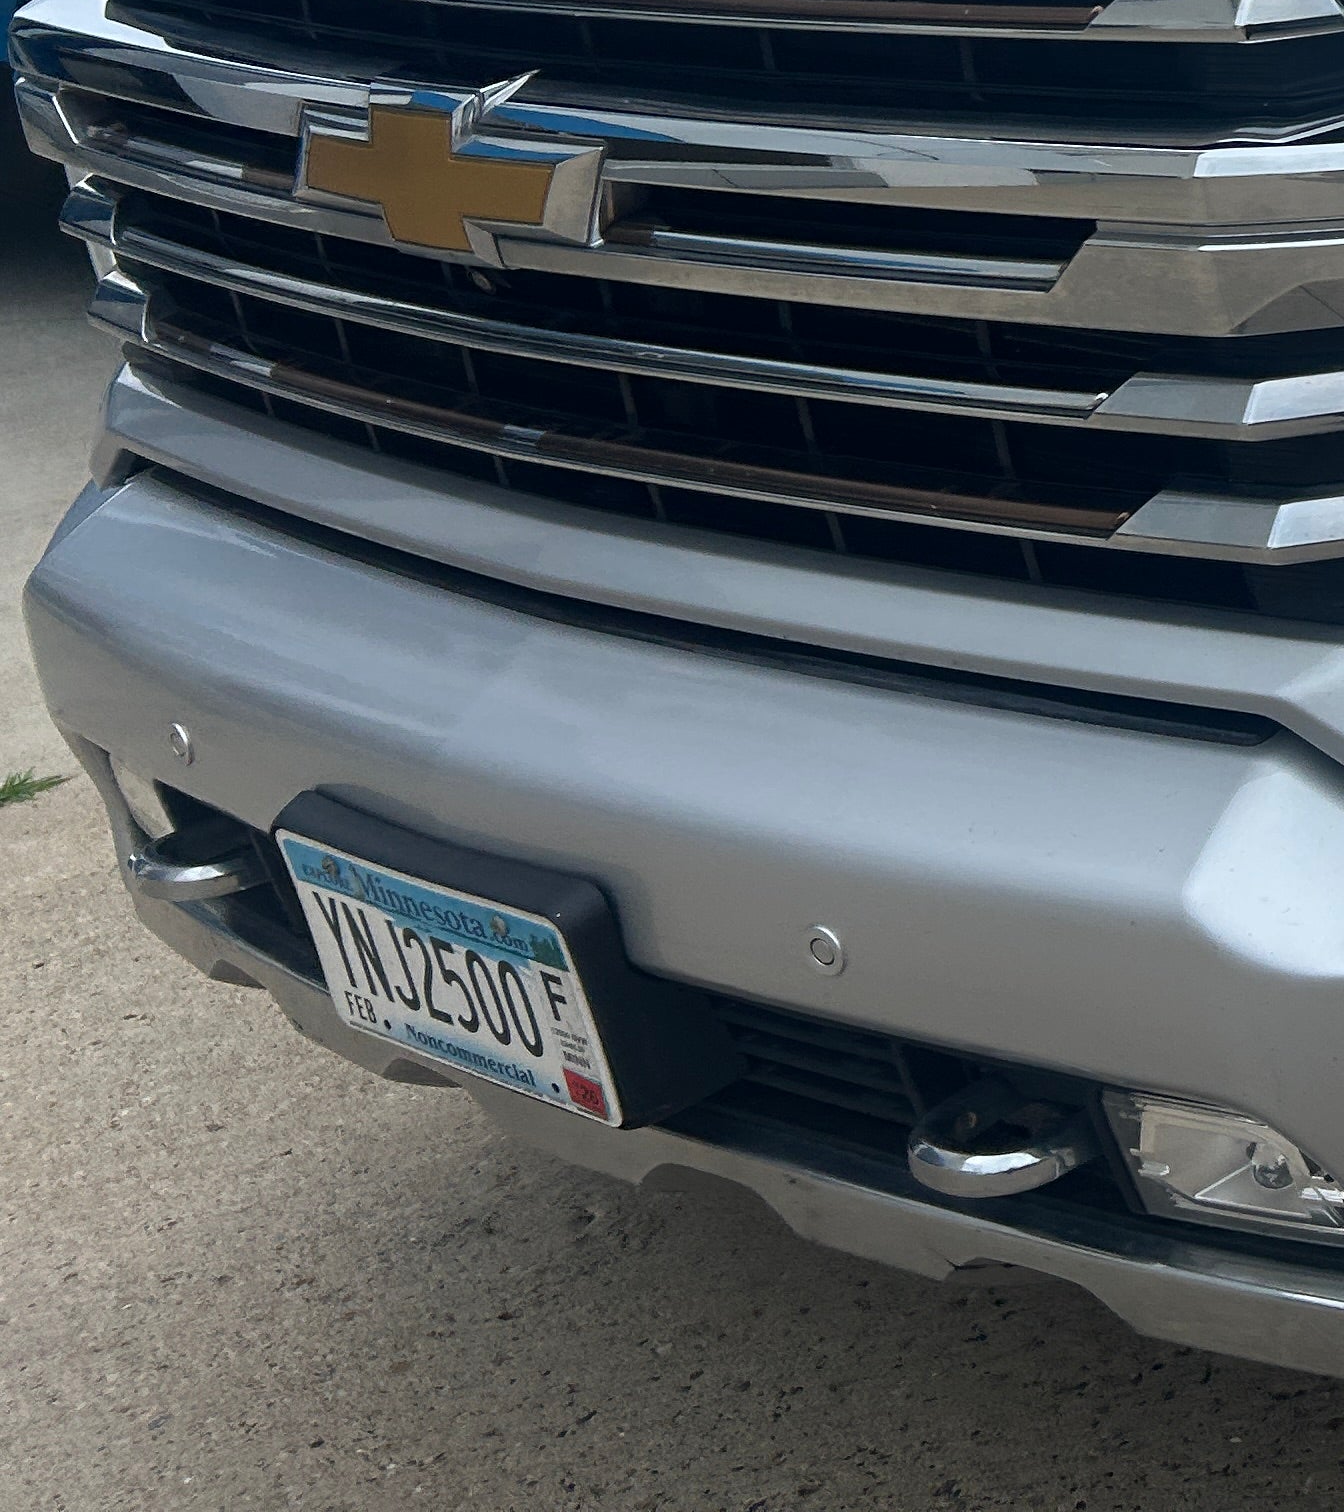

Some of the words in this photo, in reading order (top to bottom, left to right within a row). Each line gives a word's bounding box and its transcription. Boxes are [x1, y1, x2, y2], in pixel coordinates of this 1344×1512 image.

[348, 864, 487, 938] Minnesota
[313, 891, 544, 1058] YNJ2500
[540, 970, 567, 1022] F
[344, 990, 378, 1024] FEB
[405, 1022, 537, 1088] Noncommercial
